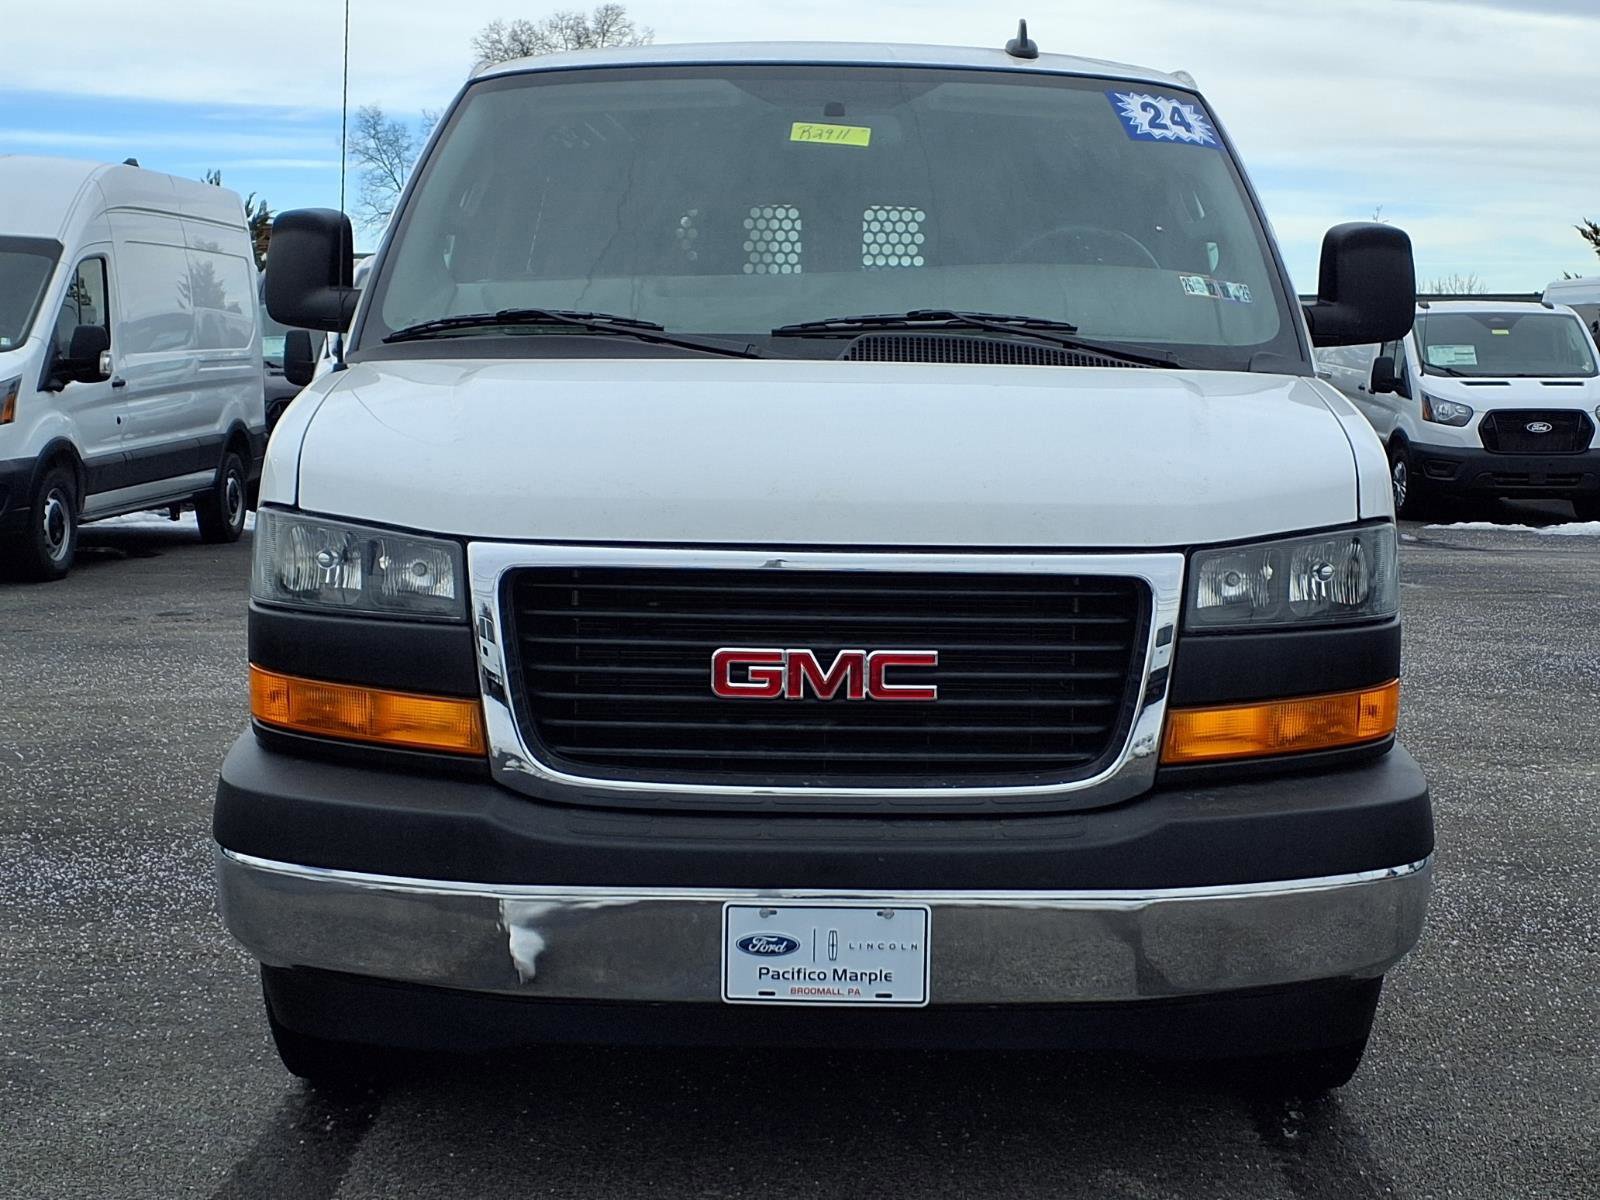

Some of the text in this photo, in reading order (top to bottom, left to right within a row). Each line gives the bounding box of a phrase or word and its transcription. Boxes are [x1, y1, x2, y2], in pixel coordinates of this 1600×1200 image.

[1140, 101, 1193, 134] 24
[711, 647, 938, 700] GMC
[748, 935, 788, 954] Ford
[849, 943, 918, 951] LINCOLN
[758, 966, 893, 985] Pacifico Marple
[847, 988, 861, 997] PA
